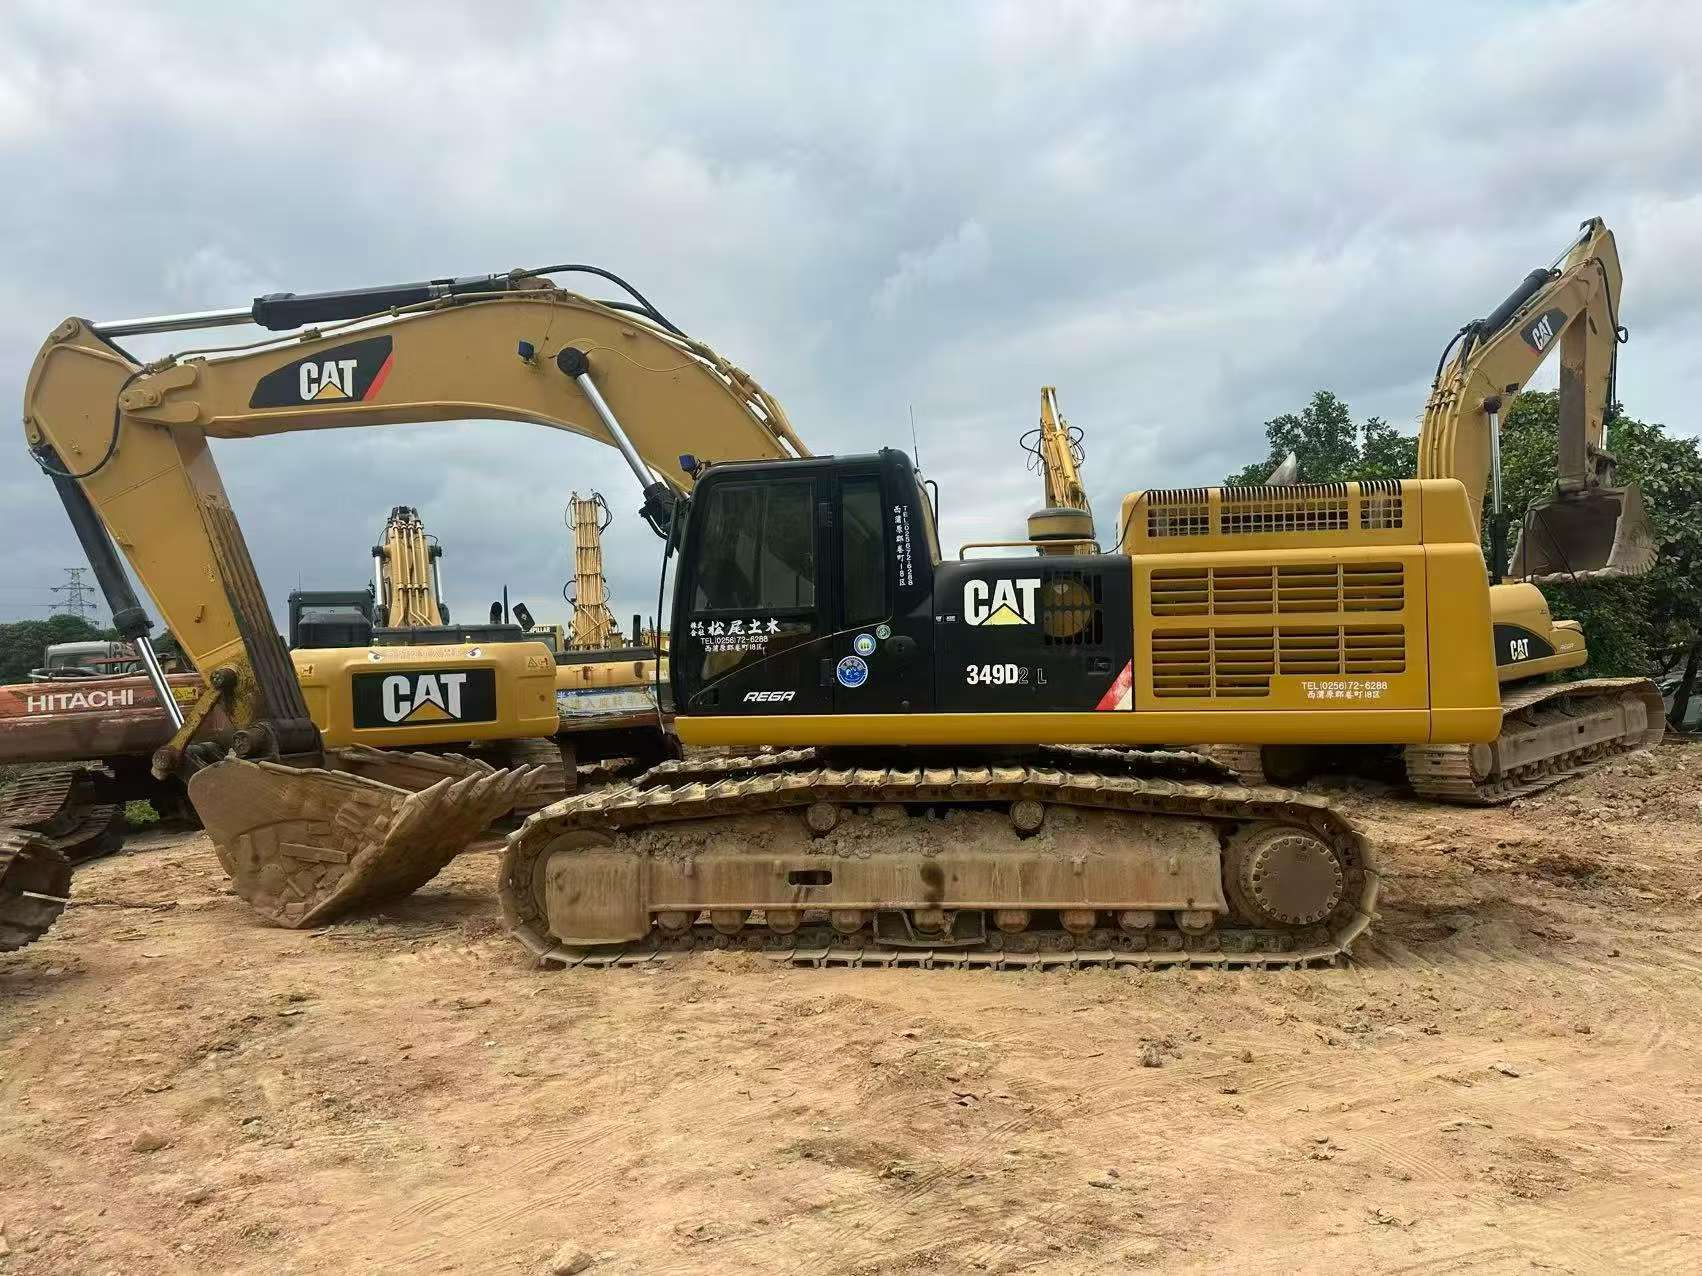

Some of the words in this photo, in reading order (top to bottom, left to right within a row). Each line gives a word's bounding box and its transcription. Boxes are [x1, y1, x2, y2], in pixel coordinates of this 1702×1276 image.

[1532, 314, 1553, 351] CAT
[299, 359, 358, 401] CAT
[963, 578, 1041, 626] CAT
[707, 617, 782, 637] 松尾土木
[1510, 638, 1529, 661] CAT
[1037, 668, 1047, 685] L
[27, 689, 134, 713] HITACHI
[382, 672, 467, 723] CAT
[742, 691, 796, 702] REGA
